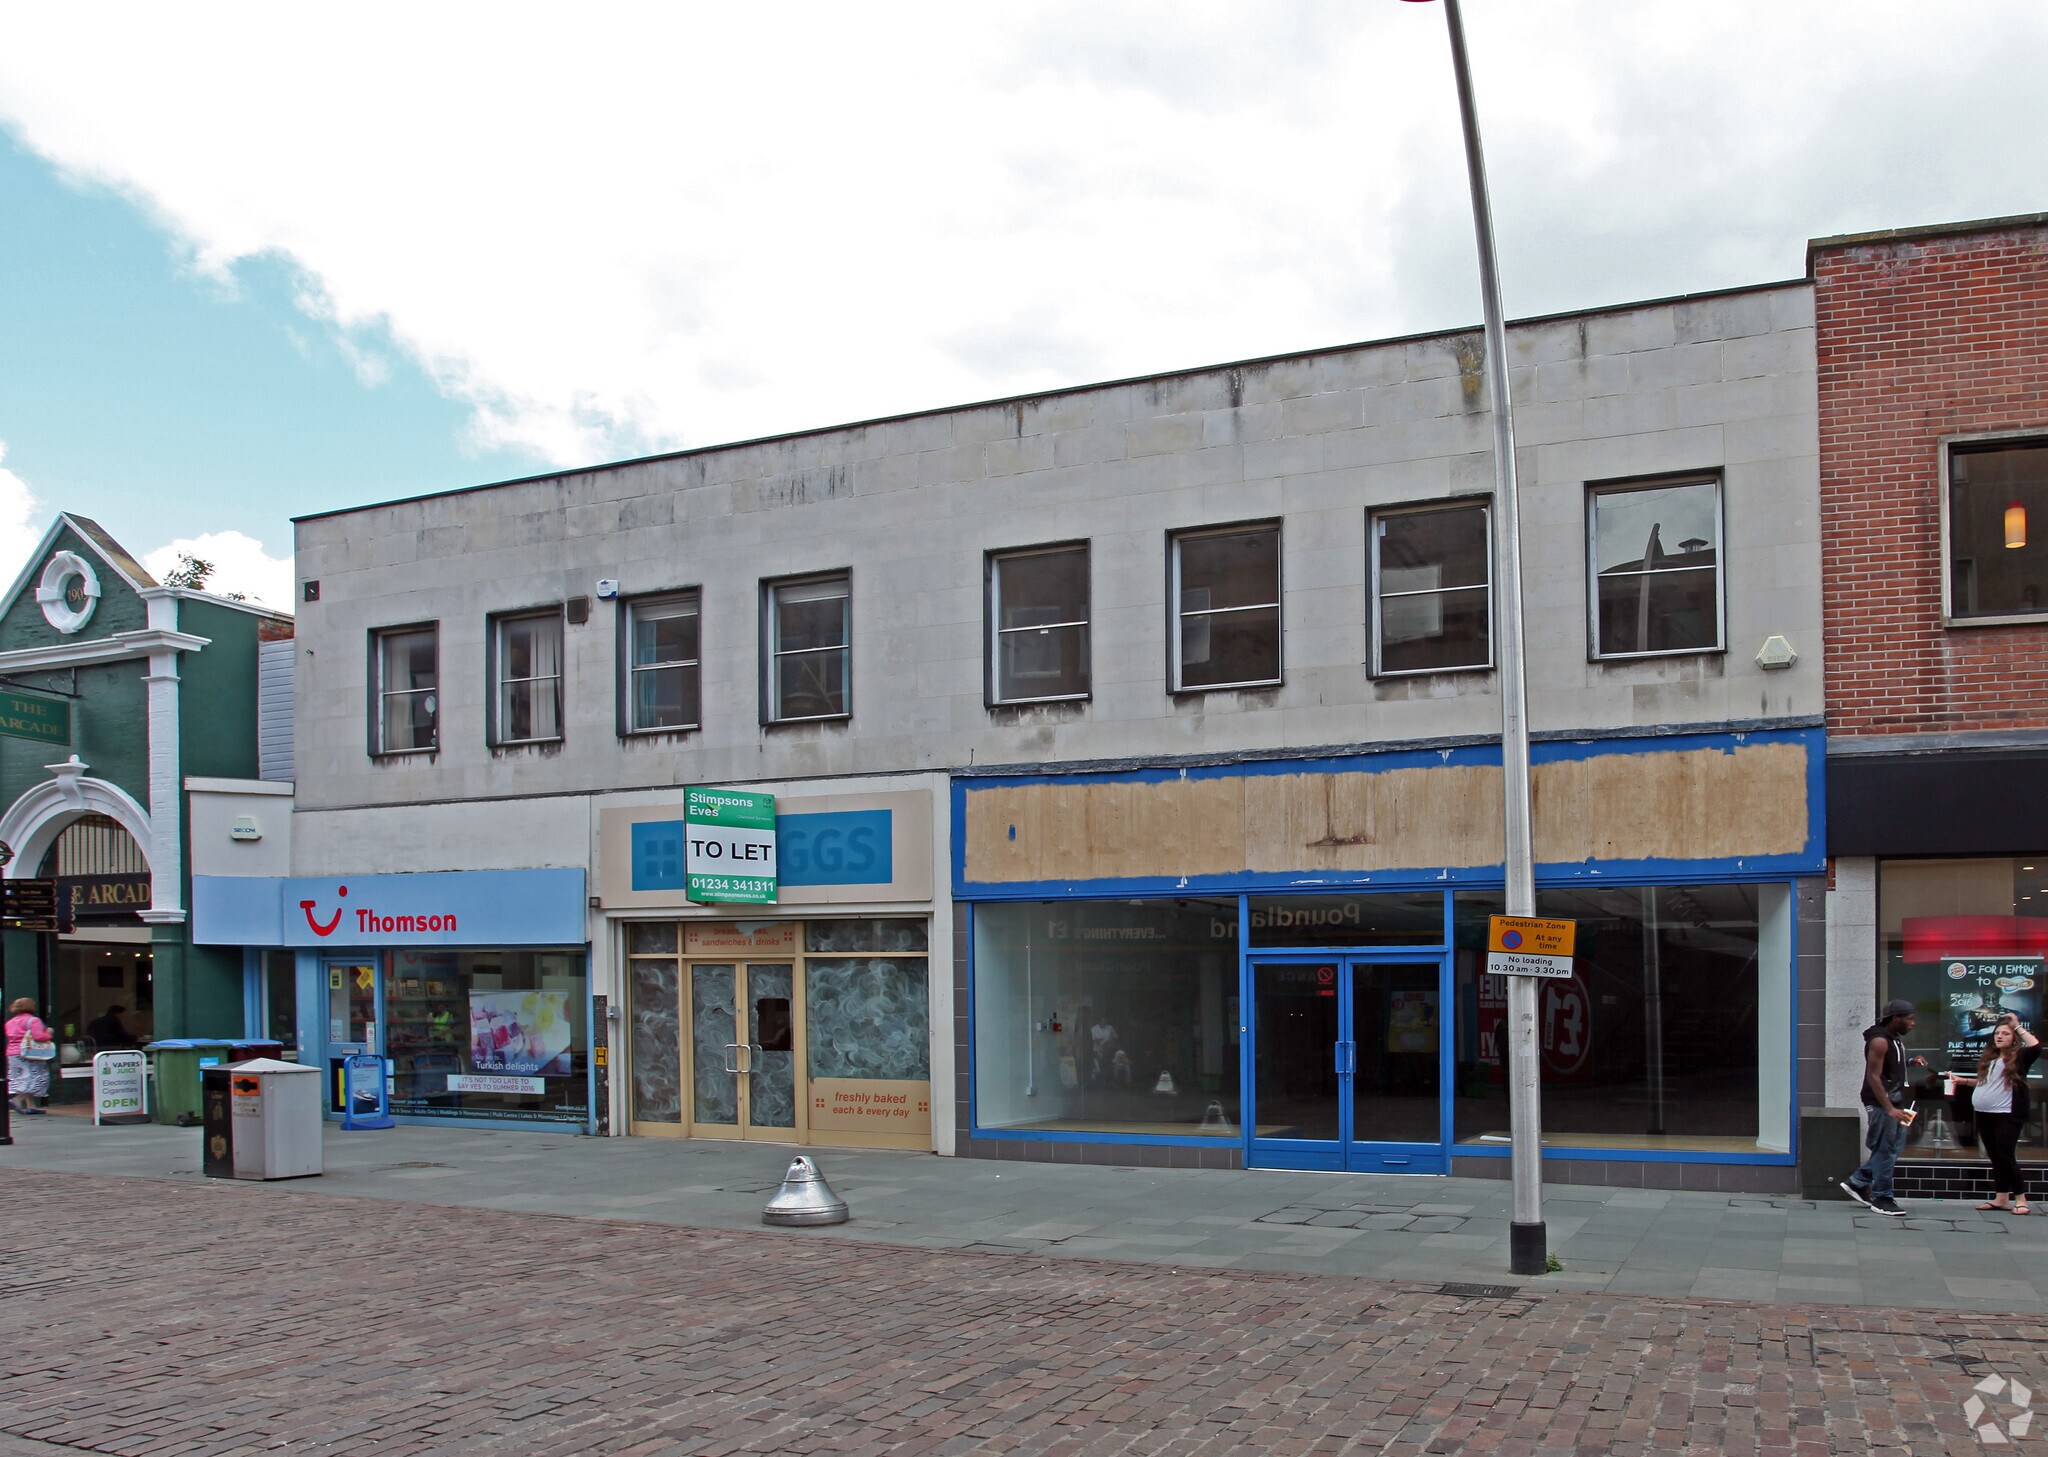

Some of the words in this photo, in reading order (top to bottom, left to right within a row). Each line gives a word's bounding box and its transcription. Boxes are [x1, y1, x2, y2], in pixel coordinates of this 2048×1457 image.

[12, 700, 47, 716] THE
[0, 716, 63, 736] ARCADE
[690, 793, 753, 807] Stimpsons
[689, 805, 719, 817] Eves
[691, 840, 723, 858] TO
[731, 843, 772, 861] LET
[780, 826, 875, 873] GGS
[692, 878, 729, 889] 01234
[733, 880, 774, 892] 341311
[88, 883, 151, 905] ARCAD
[356, 909, 457, 933] Thomson
[1500, 919, 1543, 928] Pedestrian
[1546, 922, 1566, 930] Zone
[702, 938, 745, 946] sandwiches
[755, 938, 780, 946] drinks
[1522, 957, 1553, 966] loading
[1490, 964, 1514, 972] 10.30
[1967, 964, 1976, 974] 2
[1979, 964, 1997, 975] FOR
[1950, 998, 1973, 1007] 2016
[1948, 1041, 1964, 1049] PLUS
[476, 1061, 503, 1070] Turkish
[505, 1062, 539, 1072] delights
[102, 1087, 138, 1096] Cigarettes
[102, 1097, 138, 1108] OPEN
[835, 1091, 870, 1105] freshly
[874, 1093, 907, 1104] baked
[832, 1105, 854, 1114] each
[857, 1106, 863, 1115] &
[866, 1108, 891, 1117] every
[893, 1107, 909, 1118] day
